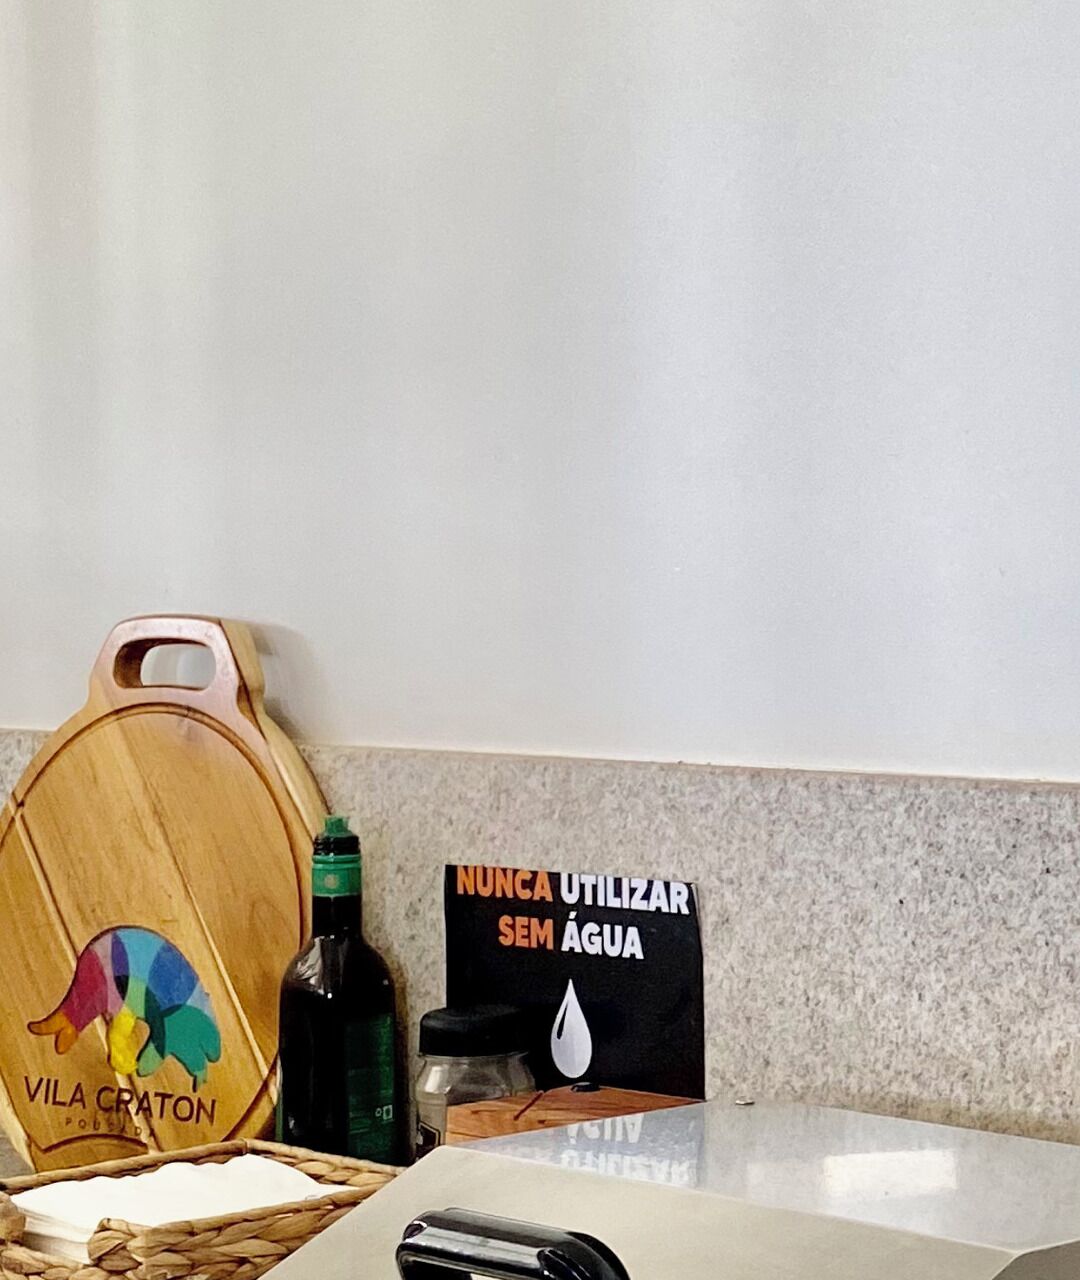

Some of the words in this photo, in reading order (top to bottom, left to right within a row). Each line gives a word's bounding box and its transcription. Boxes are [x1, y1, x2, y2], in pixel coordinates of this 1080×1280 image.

[456, 865, 553, 902] NUNCA
[560, 873, 690, 915] UTILIZAR
[498, 915, 554, 950] SEM
[561, 911, 645, 960] ÁGUA
[24, 1076, 86, 1110] VILA
[95, 1085, 216, 1126] CRATON
